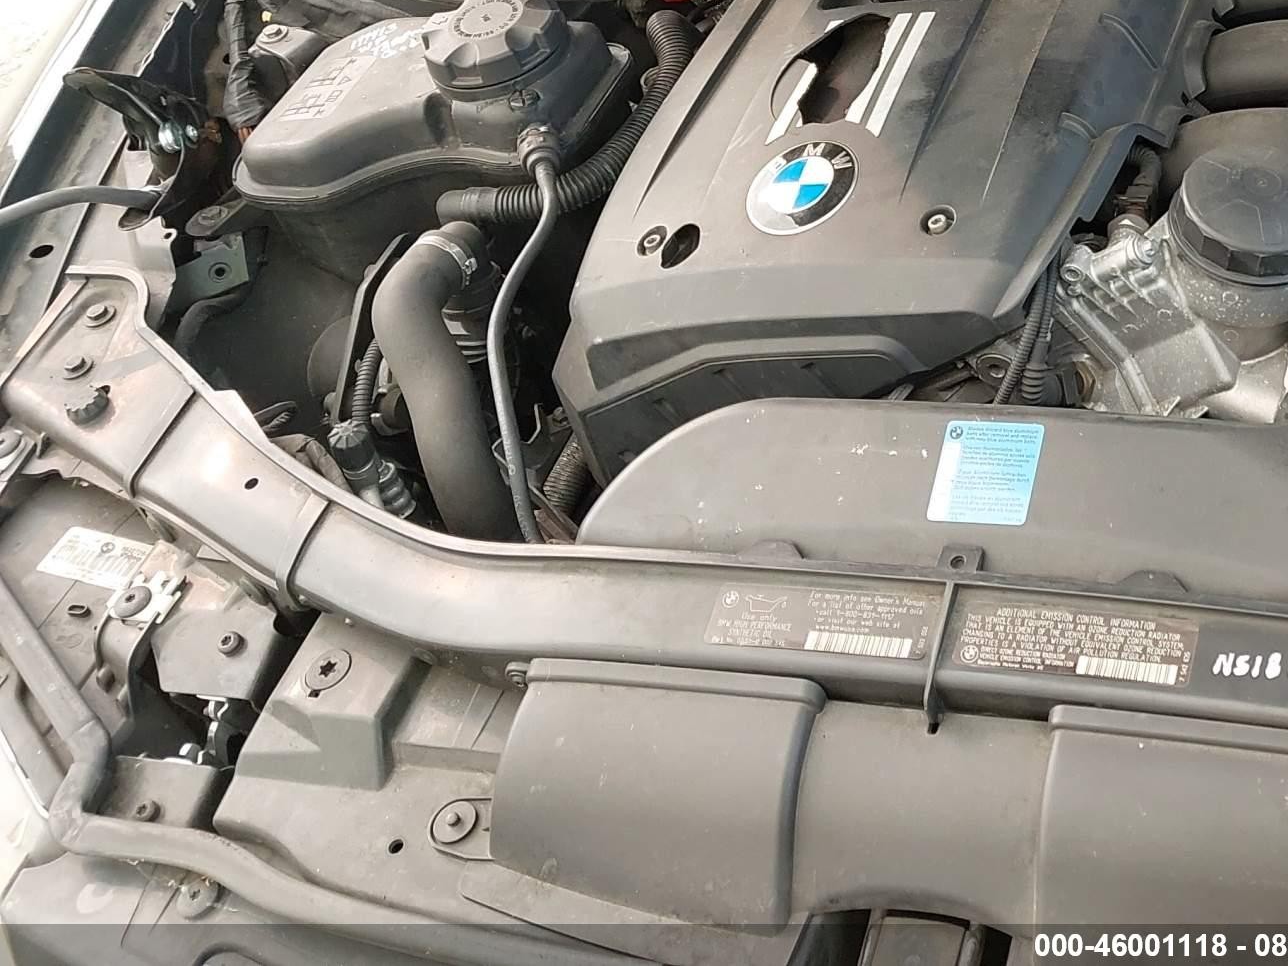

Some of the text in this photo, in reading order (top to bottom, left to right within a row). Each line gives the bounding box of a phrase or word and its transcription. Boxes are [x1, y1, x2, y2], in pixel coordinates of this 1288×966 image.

[985, 615, 1012, 625] VEHICLE
[1024, 618, 1055, 629] EQUIPPED
[1058, 622, 1074, 631] WITH
[1088, 625, 1108, 634] OZONE
[1111, 627, 1146, 638] REDUCTION
[1148, 630, 1181, 641] RADIATOR
[997, 607, 1156, 631] ADDITIONAL EMISSION CONTROL INFORMATION
[960, 636, 998, 646] PROPERTIES
[1020, 641, 1055, 652] VIOLATION
[1083, 648, 1118, 658] POLLUTION
[962, 628, 994, 639] CHANGING
[1016, 634, 1047, 643] RADIATOR
[1051, 636, 1078, 645] WITHOUT
[1080, 640, 1120, 651] EQUIVALENT
[1123, 644, 1143, 653] OZONE
[1146, 646, 1182, 657] REDUCTION
[1007, 625, 1035, 634] ELEMENT
[1064, 631, 1092, 640] VEHICLE
[1094, 633, 1124, 644] EMISSION
[1127, 636, 1154, 647] CONTROL
